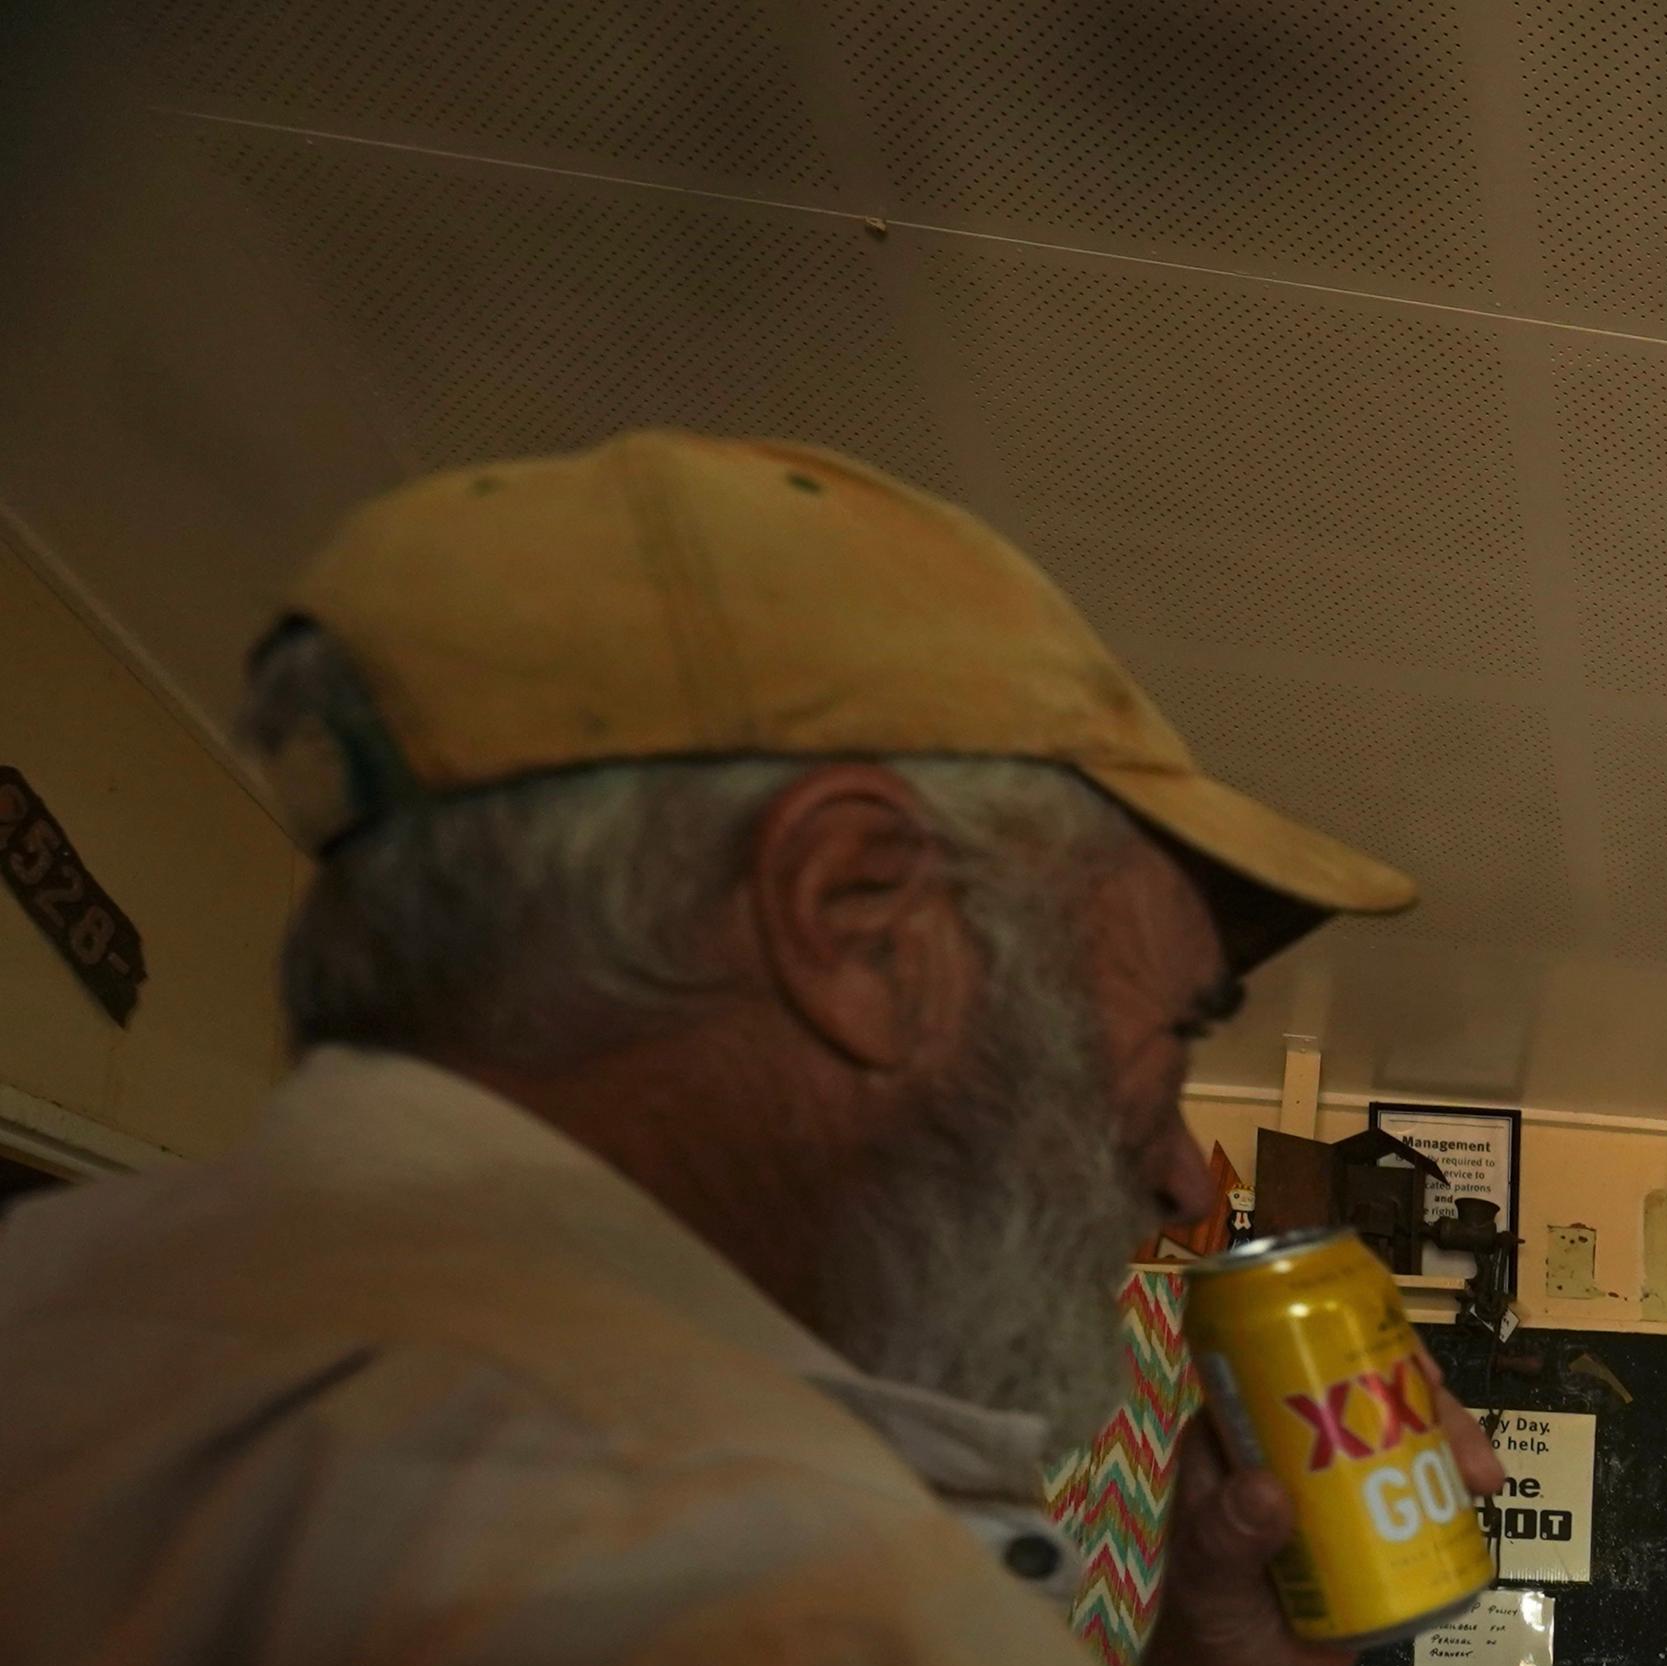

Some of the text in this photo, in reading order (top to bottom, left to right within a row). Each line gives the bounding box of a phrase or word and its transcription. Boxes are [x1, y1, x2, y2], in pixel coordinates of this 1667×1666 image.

[1401, 1135, 1492, 1153] Management
[1441, 1155, 1496, 1168] required to
[1474, 1170, 1485, 1180] to
[1454, 1183, 1492, 1193] patrons
[1434, 1194, 1454, 1204] and
[1431, 1207, 1455, 1218] right
[1516, 1417, 1551, 1434] Day.
[1507, 1436, 1550, 1456] help.
